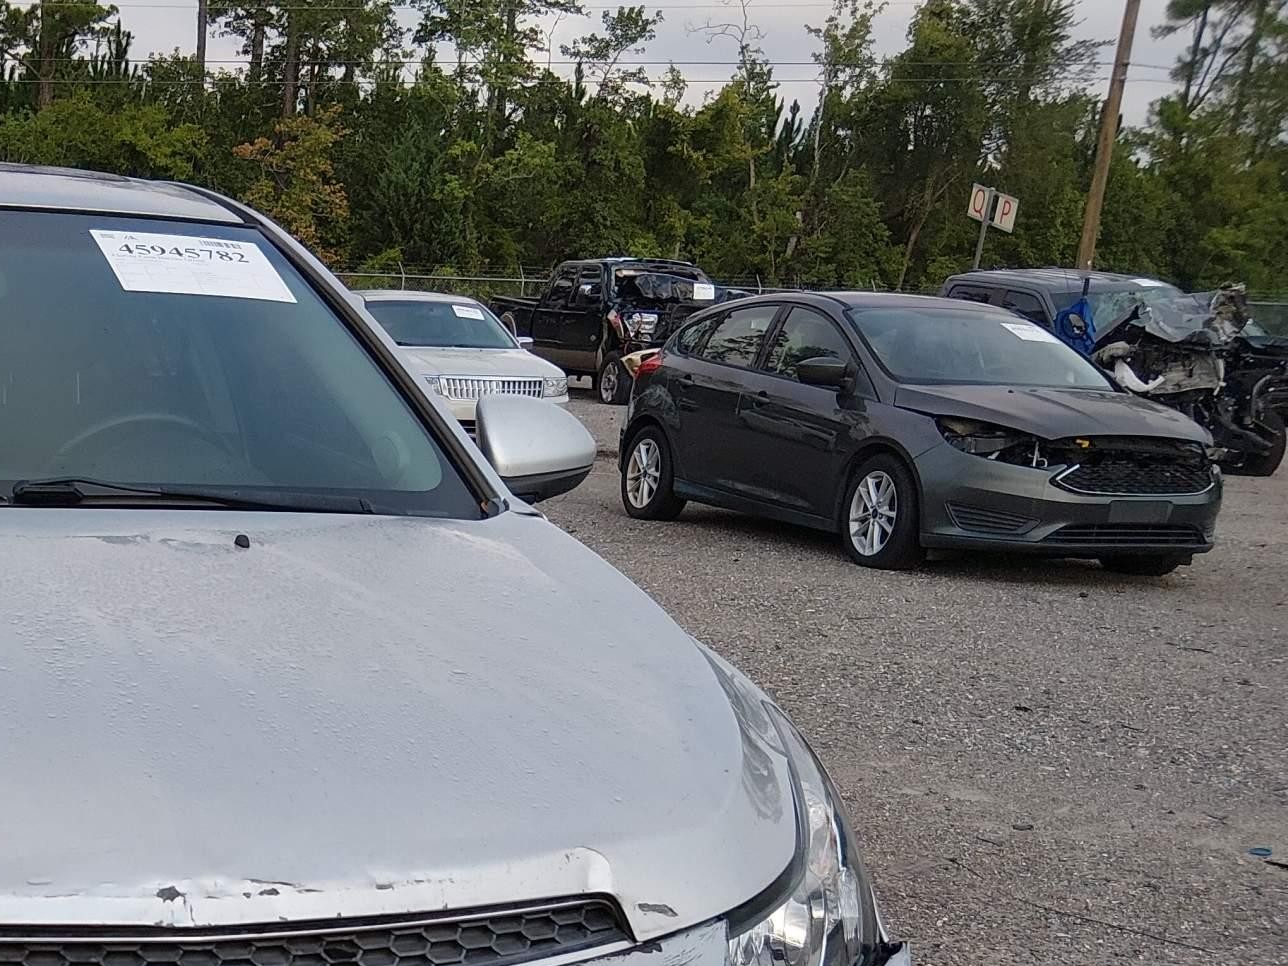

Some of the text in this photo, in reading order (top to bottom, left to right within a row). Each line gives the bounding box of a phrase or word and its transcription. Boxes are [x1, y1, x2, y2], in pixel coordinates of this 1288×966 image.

[973, 189, 1011, 225] Q P
[118, 243, 250, 264] 45945782
